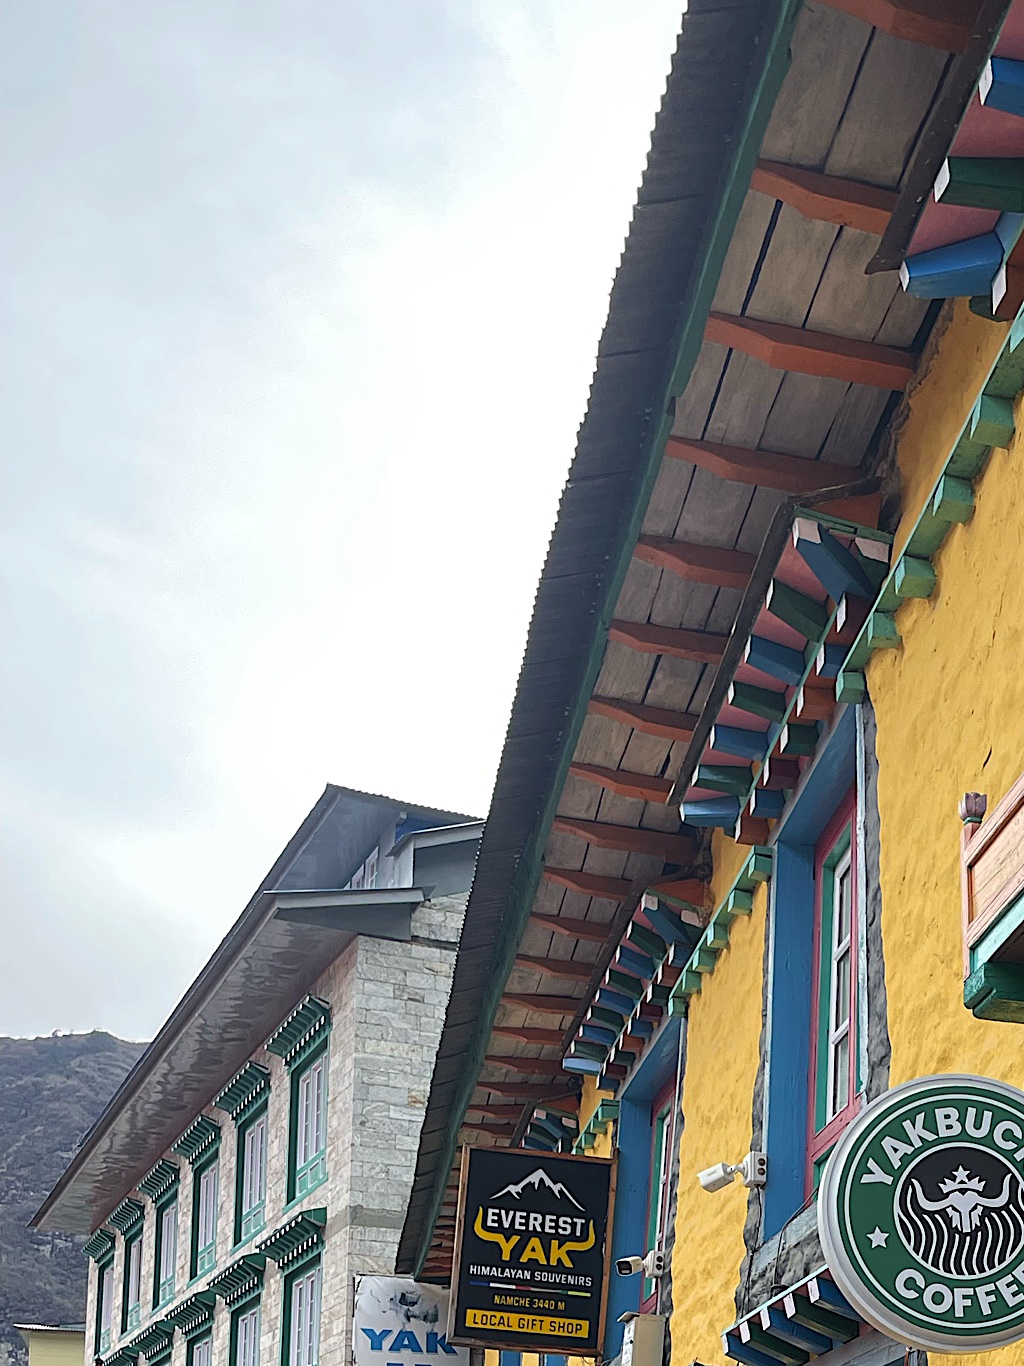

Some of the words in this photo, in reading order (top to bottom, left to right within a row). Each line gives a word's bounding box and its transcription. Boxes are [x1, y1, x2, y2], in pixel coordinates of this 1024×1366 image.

[487, 1208, 585, 1236] EVEREST
[469, 1265, 531, 1280] HIMALAYAN
[534, 1272, 592, 1286] SOUVENIRS
[494, 1295, 530, 1307] NAMCHE
[533, 1299, 555, 1309] 3440
[558, 1302, 565, 1310] M
[473, 1313, 512, 1327] LOCAL
[518, 1318, 544, 1330] GIFT
[549, 1321, 582, 1334] SHOP
[360, 1328, 458, 1356] YAK
